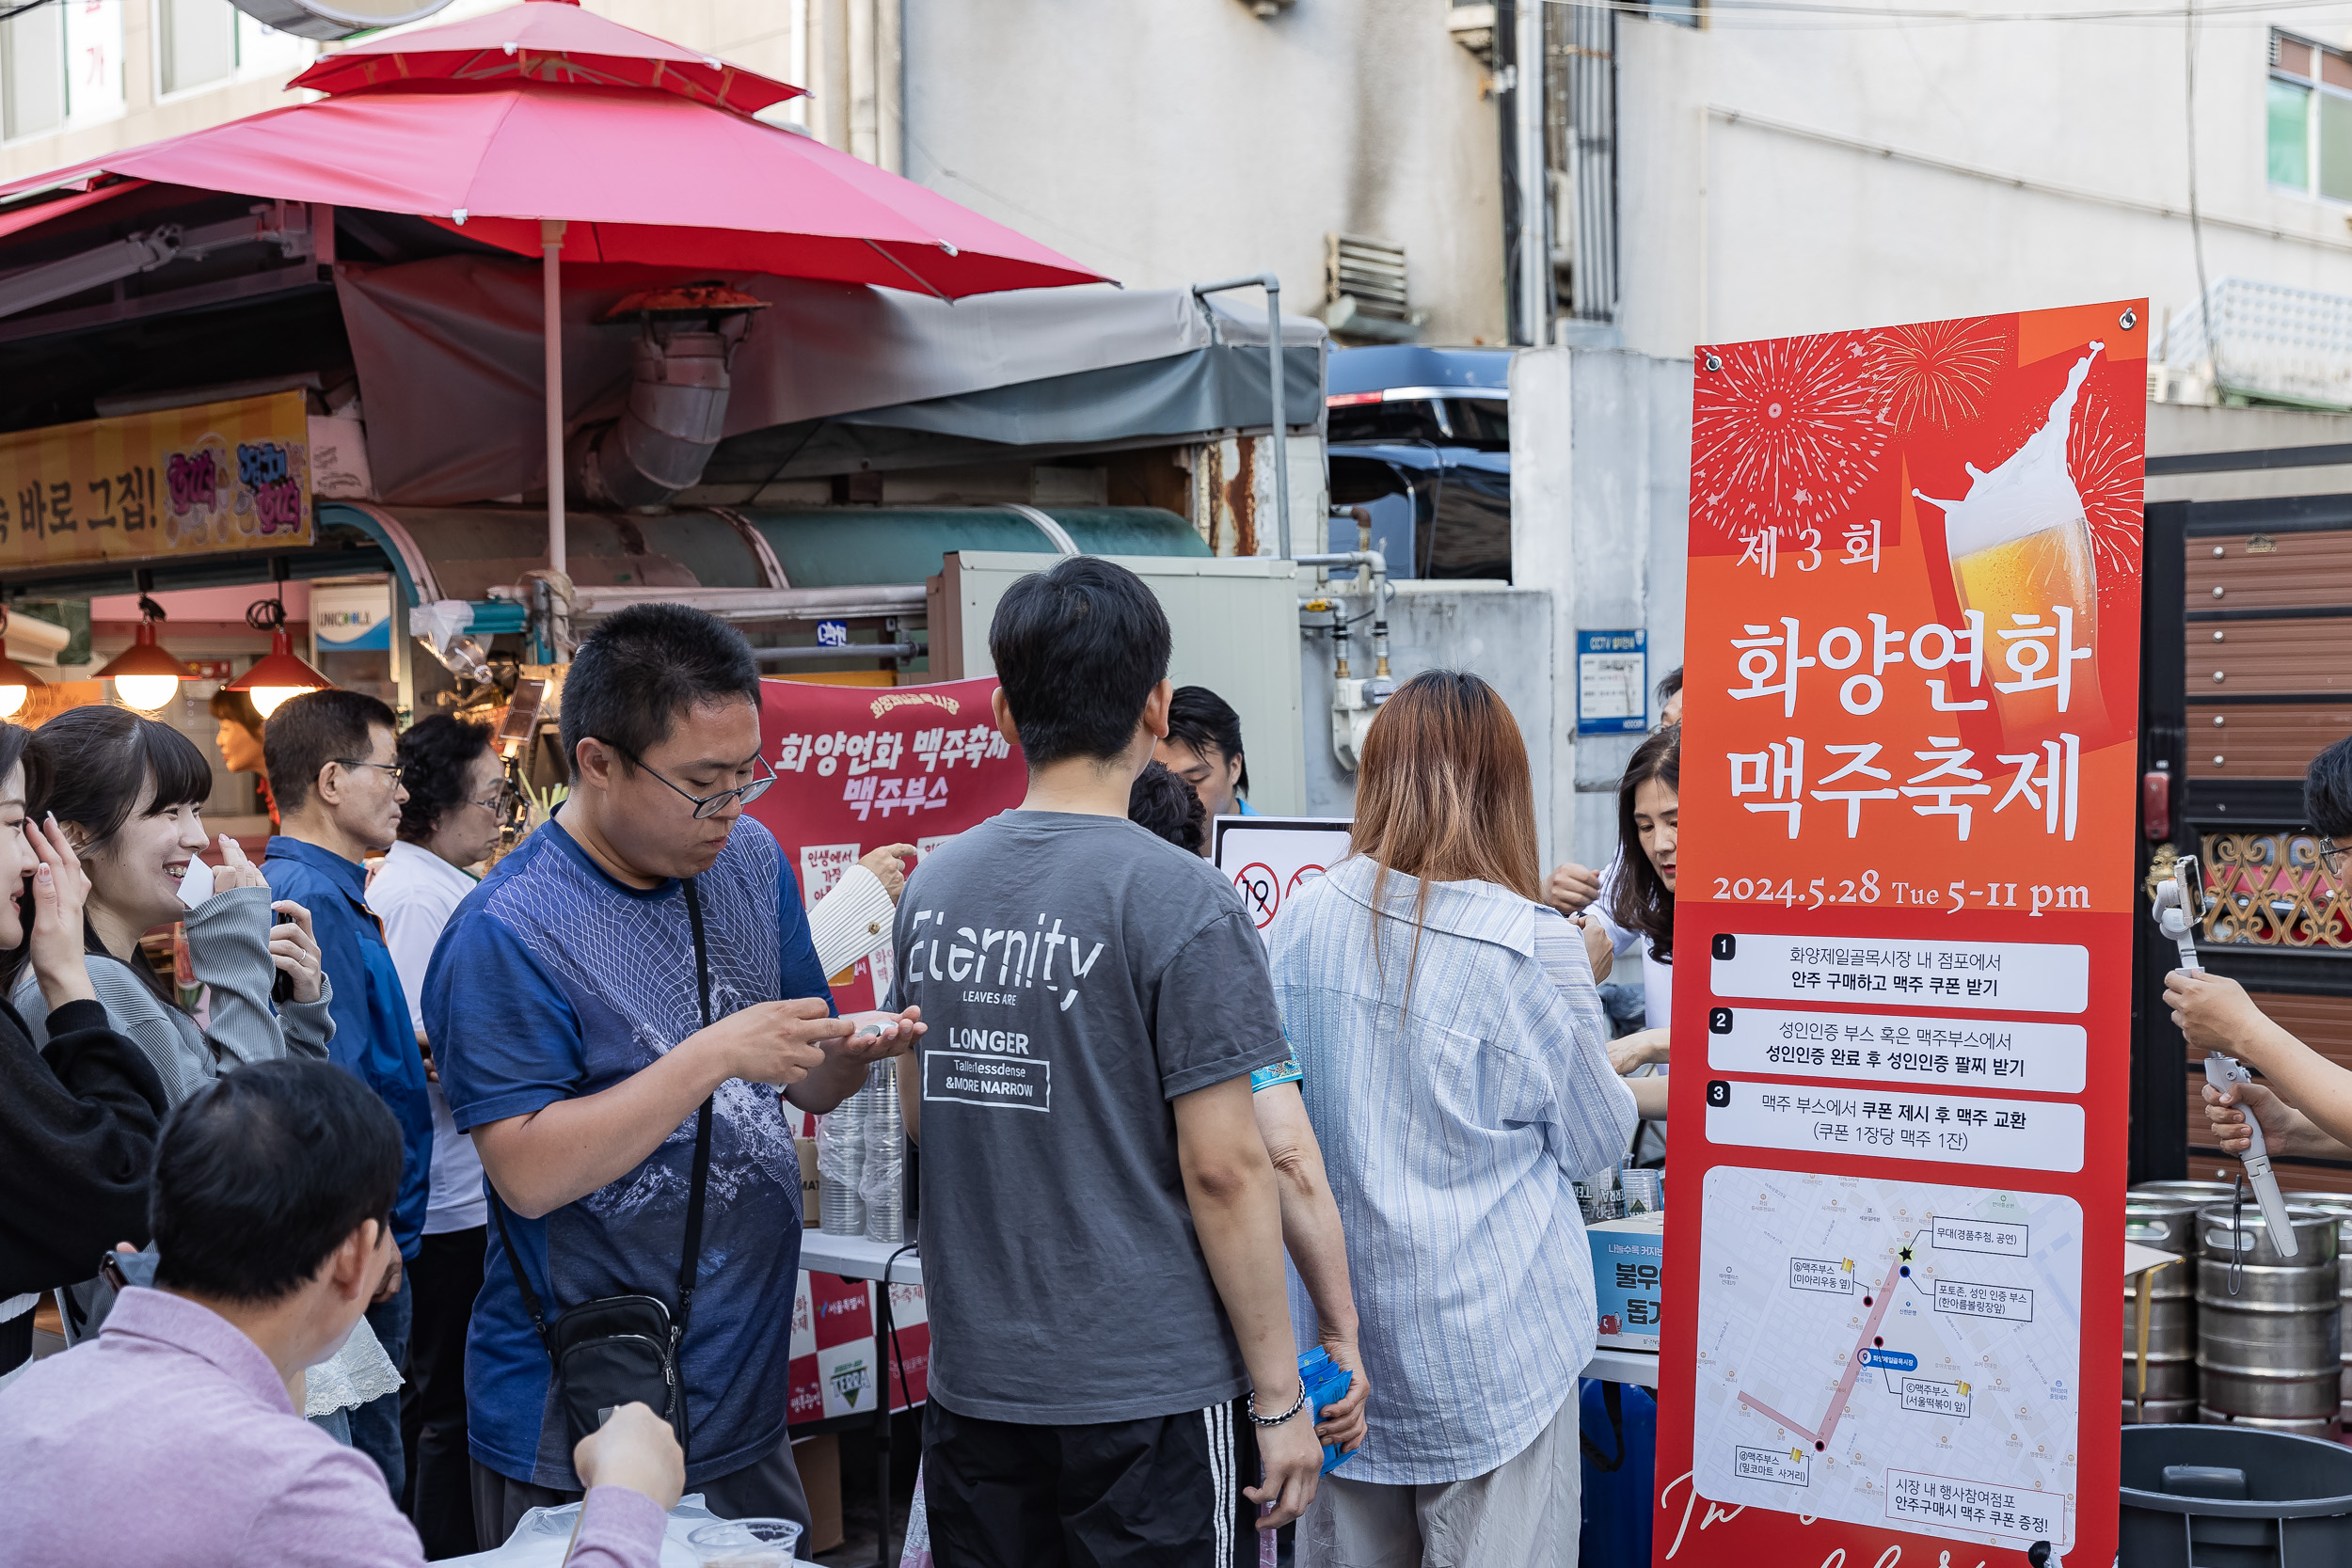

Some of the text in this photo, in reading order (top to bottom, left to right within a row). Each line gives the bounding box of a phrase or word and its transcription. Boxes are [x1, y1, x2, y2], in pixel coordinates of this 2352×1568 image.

[18, 480, 77, 540] 바로
[87, 467, 157, 532] 그집!
[1737, 519, 1882, 578] 제 3 회
[1726, 605, 2092, 718] 화양연화
[774, 723, 1010, 777] 화양연화 맥주축제
[843, 775, 948, 821] 맥주부스
[1725, 732, 2080, 842] 맥주축제
[807, 849, 852, 867] 인생에서
[1242, 879, 1269, 911] 19
[1712, 869, 2091, 917] 2024.5.28 Tue 5-11 pm
[1720, 939, 1727, 954] 1
[1789, 945, 2002, 972] 화양제일골목시장 내 점포에서
[962, 990, 1017, 1006] LEAVES ARE
[1791, 971, 1998, 998] 안주 구매하고 맥주 쿠폰 받기
[1715, 1013, 1726, 1027] 2
[949, 1027, 1029, 1055] LONGER
[1778, 1021, 2012, 1052] 성인인증 부스 혹은 맥주부스에서
[1765, 1044, 2026, 1078] 성인인증 완료 후 성인인증 팔찌 받기
[946, 1076, 1033, 1098] &MORE NARROW
[1713, 1085, 1724, 1101] 3
[1761, 1093, 2026, 1131] 맥주 부스에서 쿠폰 제시 후 맥주 교환
[1812, 1121, 1969, 1152] (쿠폰 1장당 맥주 1잔)
[1608, 1243, 1640, 1256] 나눌수록
[1936, 1227, 2017, 1245] 무대(경품추첨, 공연)
[1615, 1262, 1663, 1291] 불우
[1793, 1275, 1851, 1290] (미아리우동 옆)
[828, 1294, 866, 1315] 서울특별시
[1938, 1297, 2006, 1315] (한아름볼링장앞)
[1939, 1285, 2027, 1304] 포토존, 성인 인증 부스
[830, 1369, 871, 1398] TERRA
[1905, 1396, 1966, 1413] (서울떡볶이 앞)
[1739, 1463, 1805, 1482] (밀코마트 사거리)
[1896, 1479, 1921, 1496] 시장
[1924, 1482, 1936, 1497] 내
[1940, 1484, 2016, 1509] 행사참여점포
[1895, 1496, 2049, 1533] 안주구매시 맥주 쿠폰 증정!
